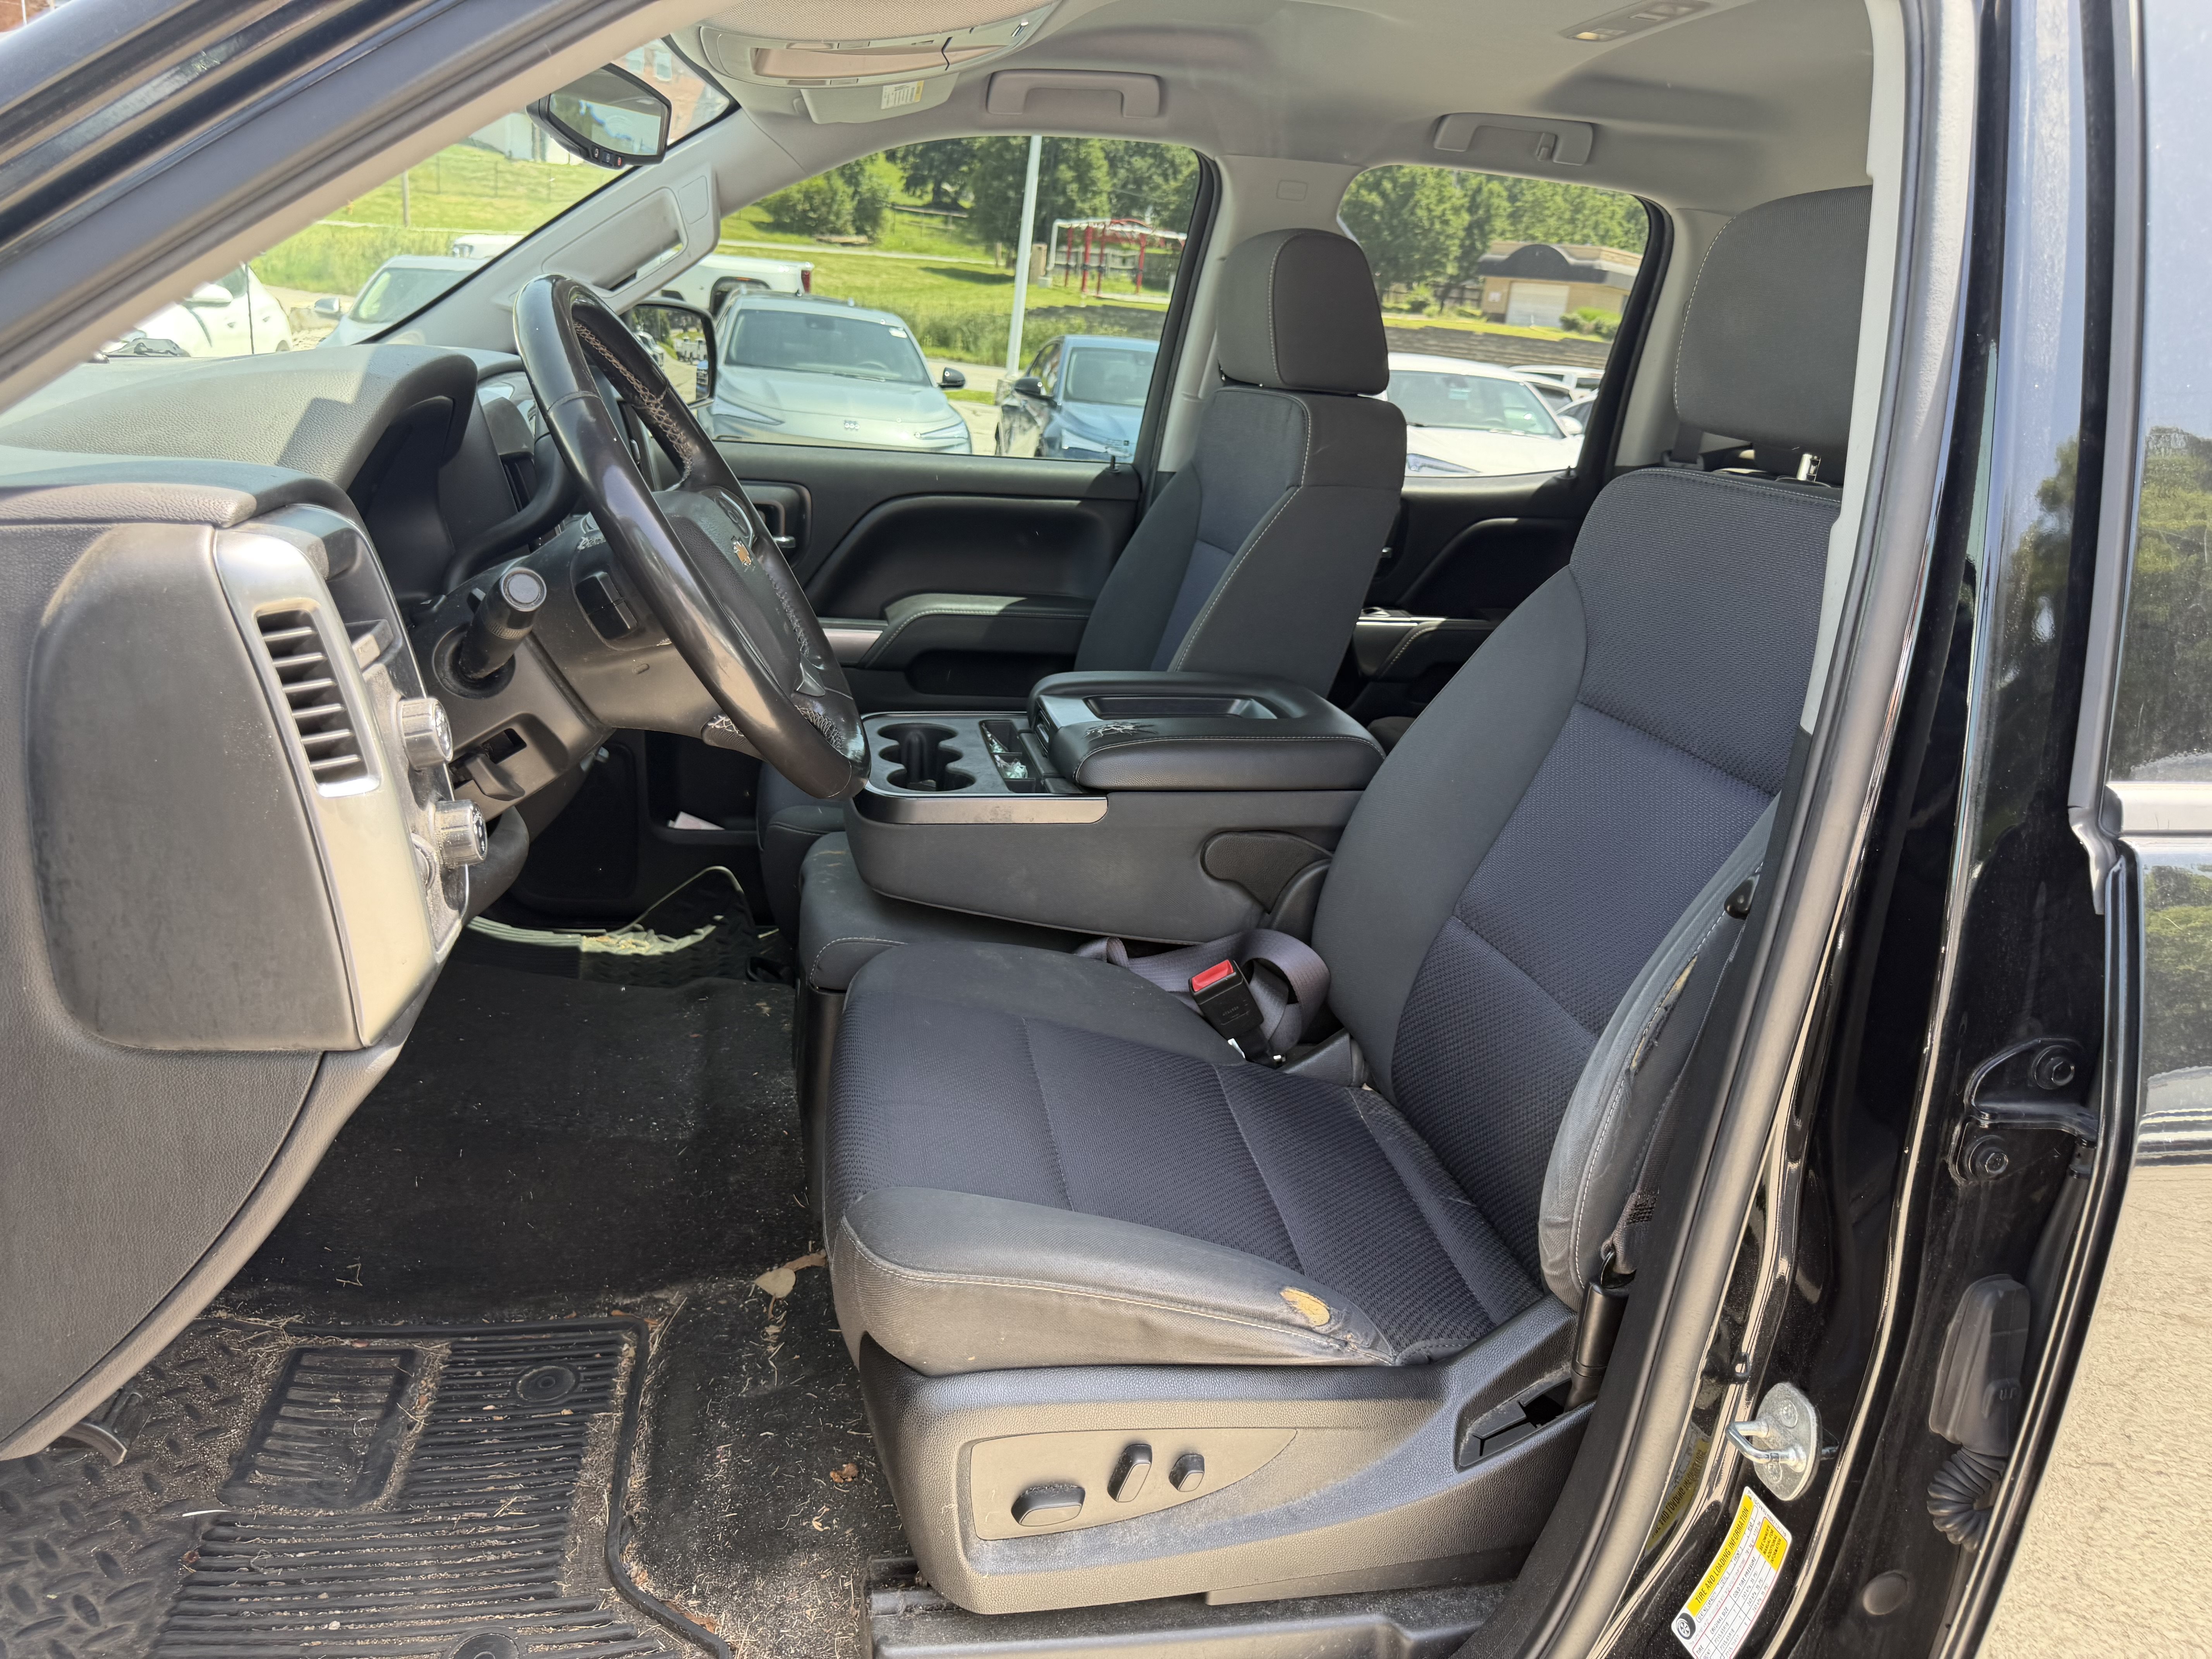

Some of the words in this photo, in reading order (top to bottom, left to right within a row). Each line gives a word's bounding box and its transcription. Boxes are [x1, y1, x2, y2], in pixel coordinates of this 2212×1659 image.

[1695, 1587, 1707, 1604] TIRE
[1705, 1575, 1716, 1590] AND
[1713, 1548, 1732, 1576] LOADING
[1728, 1506, 1749, 1550] INFORMATION
[1767, 1534, 1778, 1559] ADDITIONAL
[1770, 1538, 1781, 1564] INFORMATION
[1733, 1587, 1741, 1598] COLD
[1744, 1556, 1756, 1578] PRESSURE
